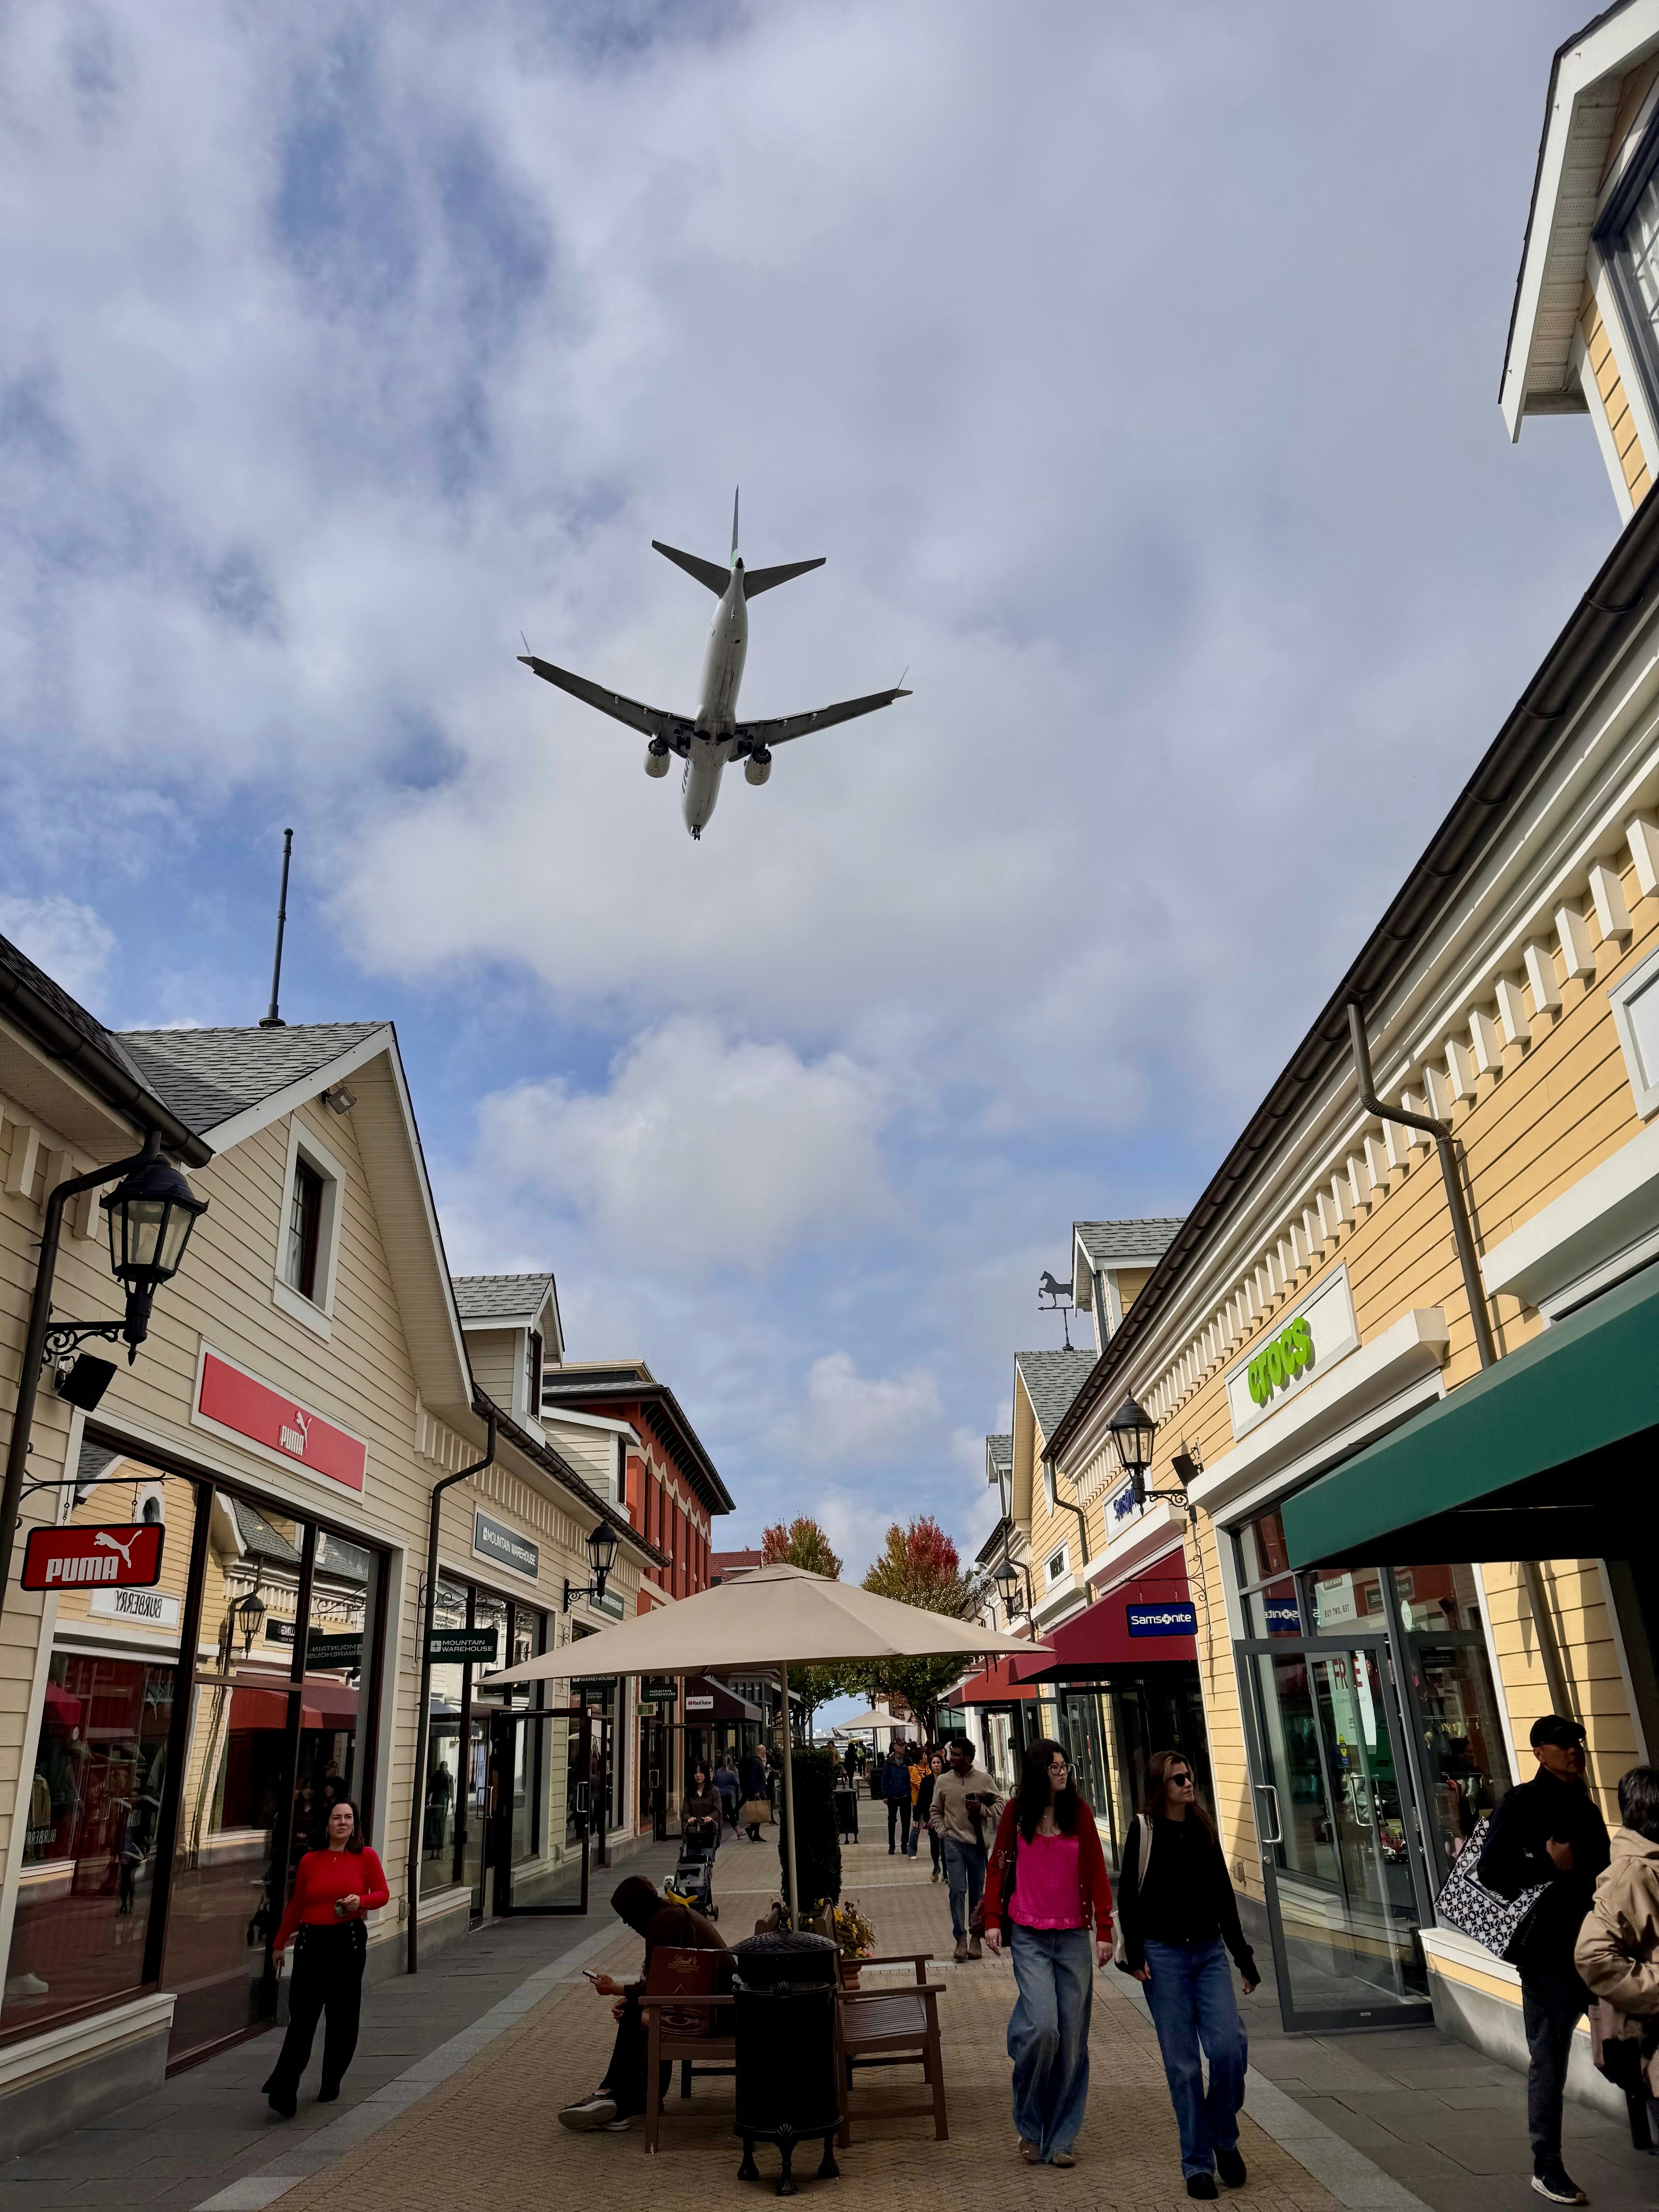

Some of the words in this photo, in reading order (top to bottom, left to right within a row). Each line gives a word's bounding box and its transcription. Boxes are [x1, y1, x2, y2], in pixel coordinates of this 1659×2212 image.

[1248, 1317, 1311, 1403] crocs
[279, 1425, 304, 1456] PUMA
[487, 1530, 510, 1553] MOUNTAIN
[511, 1542, 536, 1566] WAREHOUSE
[45, 1556, 119, 1582] PUMA
[1131, 1614, 1192, 1625] Samsonite
[1332, 1656, 1363, 1690] FRE
[672, 1955, 693, 1965] Lindt
